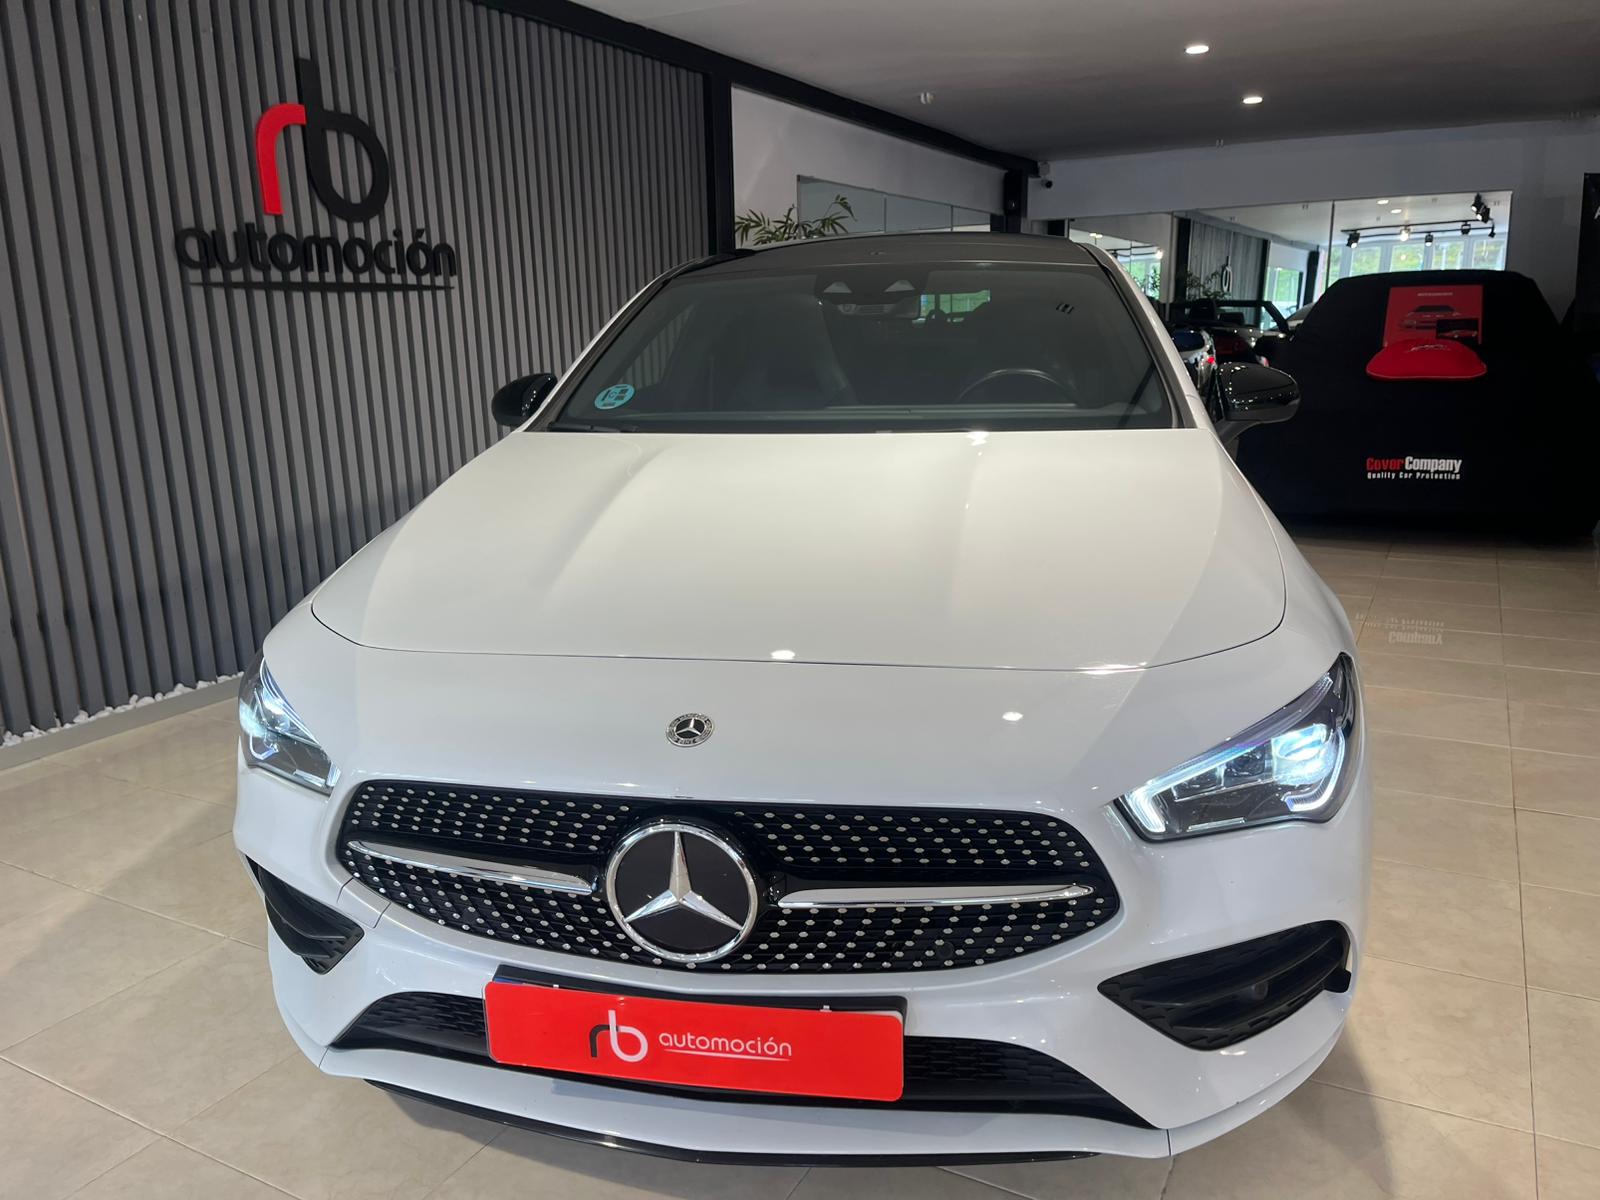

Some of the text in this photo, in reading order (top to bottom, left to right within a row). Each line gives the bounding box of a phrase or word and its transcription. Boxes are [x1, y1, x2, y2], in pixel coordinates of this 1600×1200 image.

[174, 222, 457, 277] automoción
[589, 1009, 793, 1063] rb automoción
